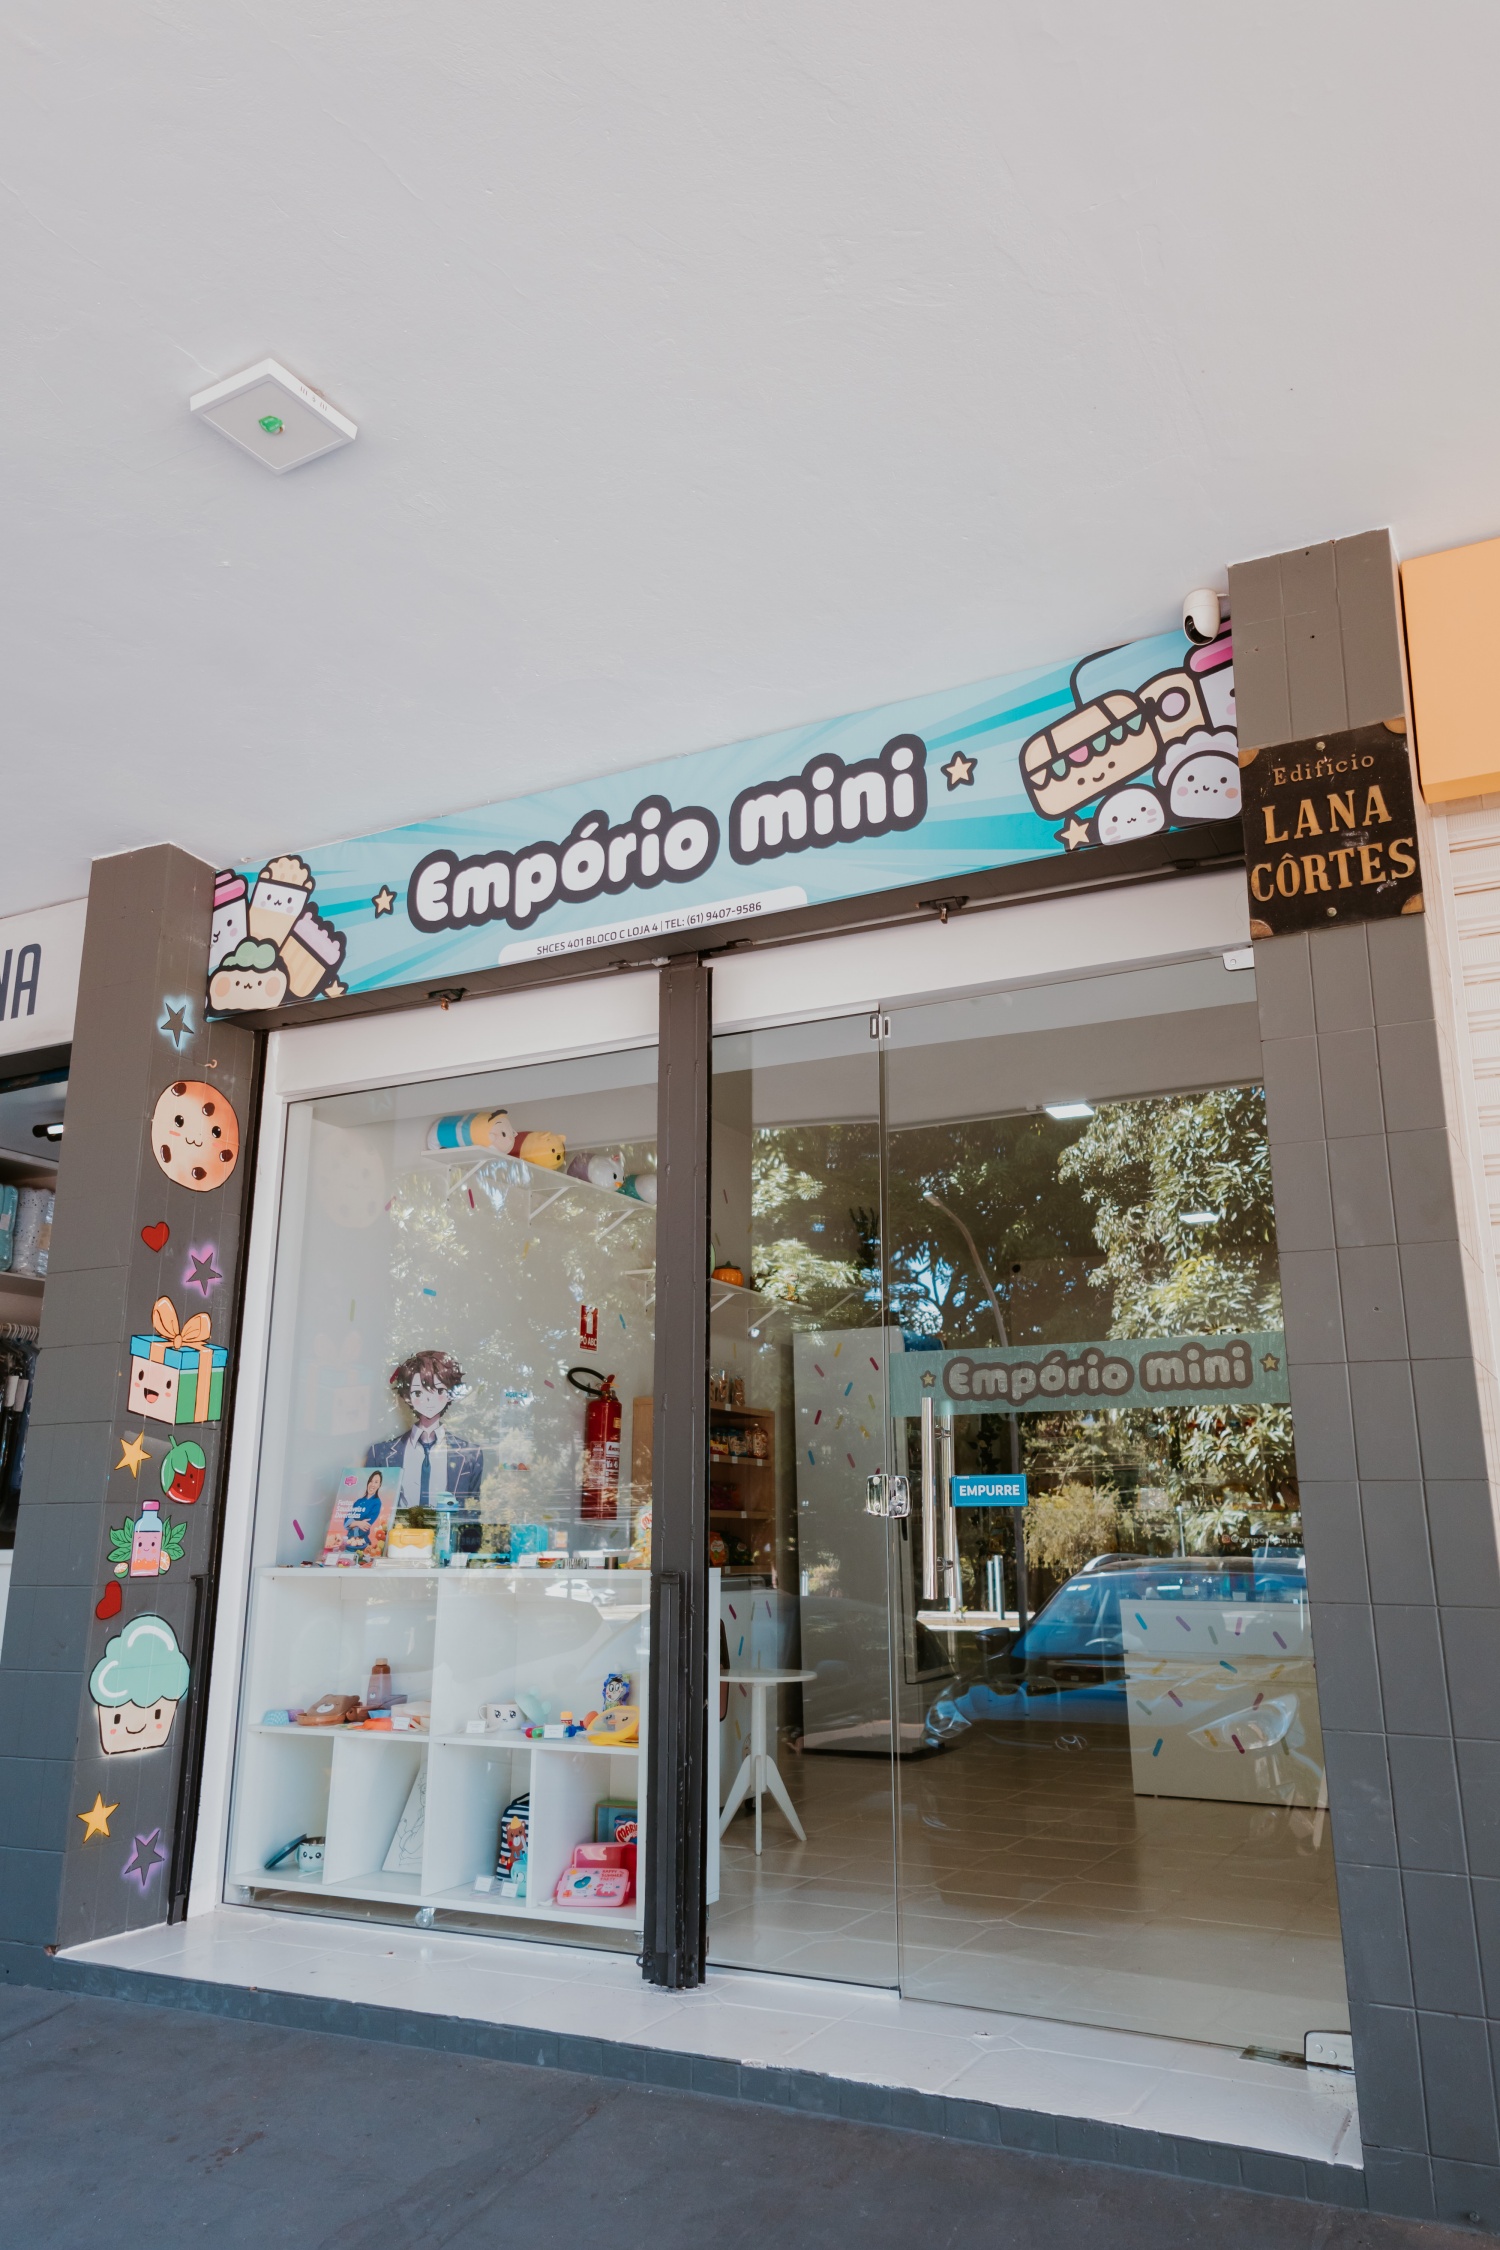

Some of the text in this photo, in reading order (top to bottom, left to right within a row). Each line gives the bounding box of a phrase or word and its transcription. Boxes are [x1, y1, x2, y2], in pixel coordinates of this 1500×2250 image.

[1272, 753, 1375, 787] Edifício
[415, 746, 915, 919] Empório mini
[1261, 784, 1393, 845] LANA
[1250, 837, 1417, 903] CÔRTES
[536, 901, 762, 956] SHCES 401 BLOCO C LOJA 4 TEL: (61) 9407-9586
[948, 1345, 1247, 1401] Empório mini
[959, 1484, 1021, 1497] EMPURRE
